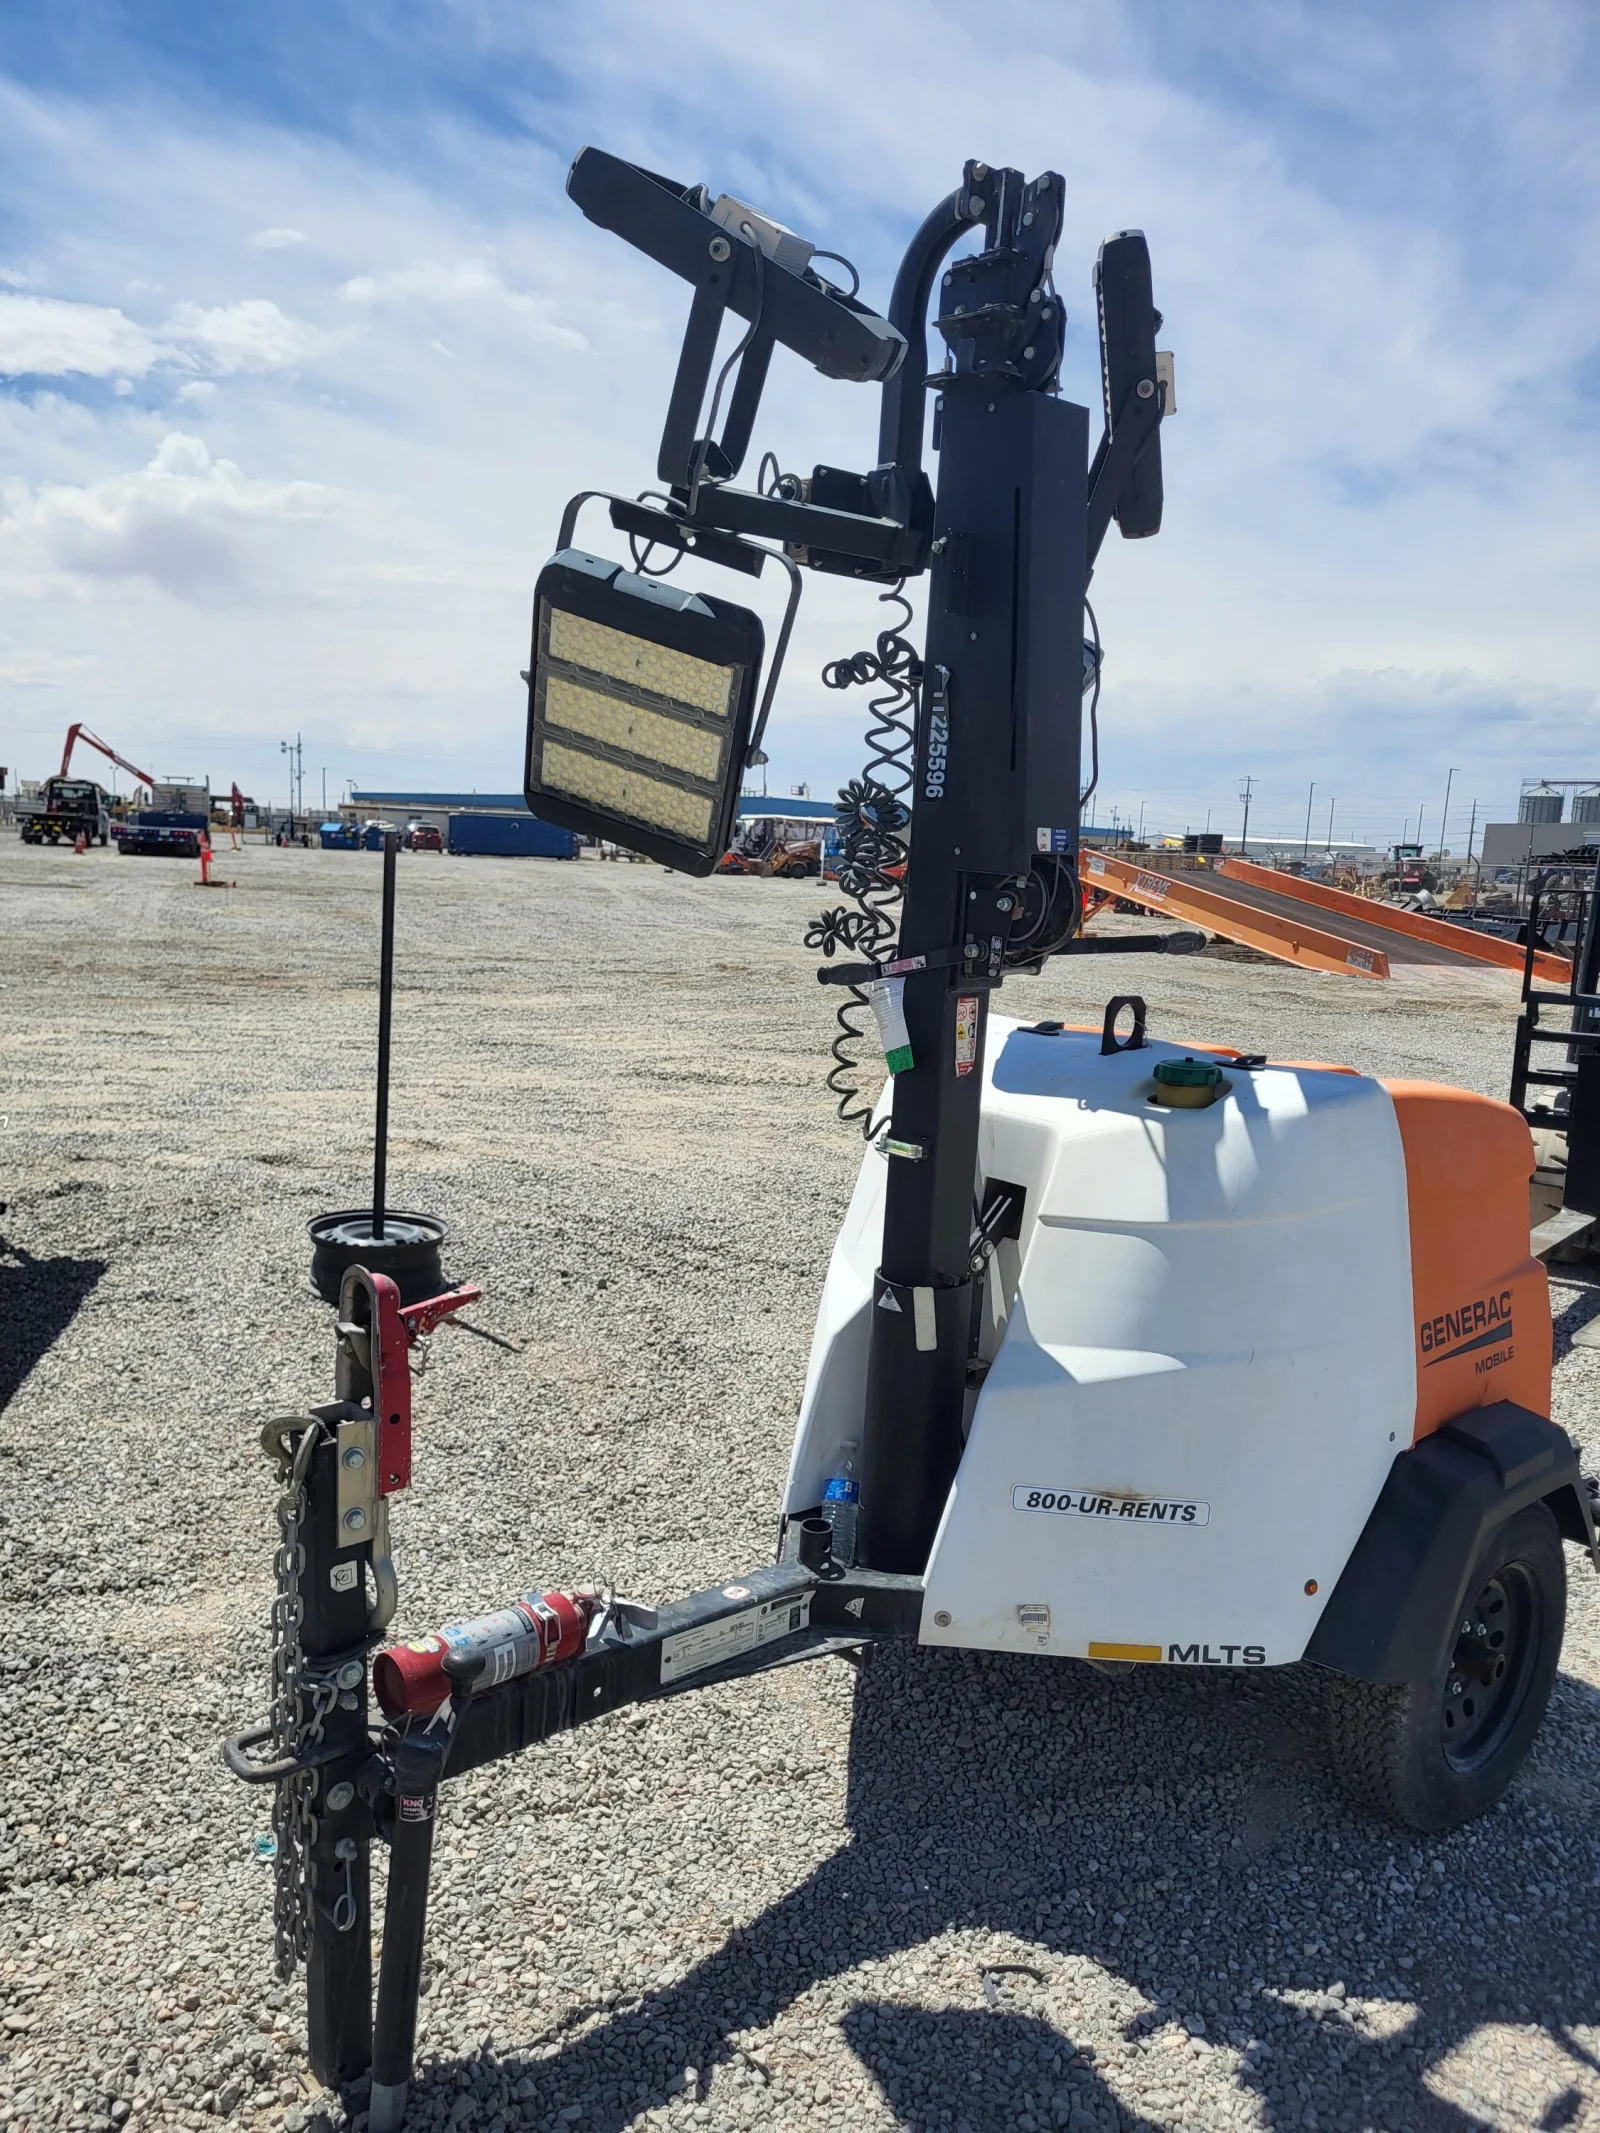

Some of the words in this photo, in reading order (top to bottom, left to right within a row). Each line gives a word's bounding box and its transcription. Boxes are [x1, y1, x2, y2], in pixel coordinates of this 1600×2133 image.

[1420, 1290, 1512, 1353] GENERAC
[1475, 1345, 1515, 1376] MOBILE
[1026, 1491, 1197, 1522] 800-UR-RENTS
[1168, 1644, 1266, 1664] MLTS
